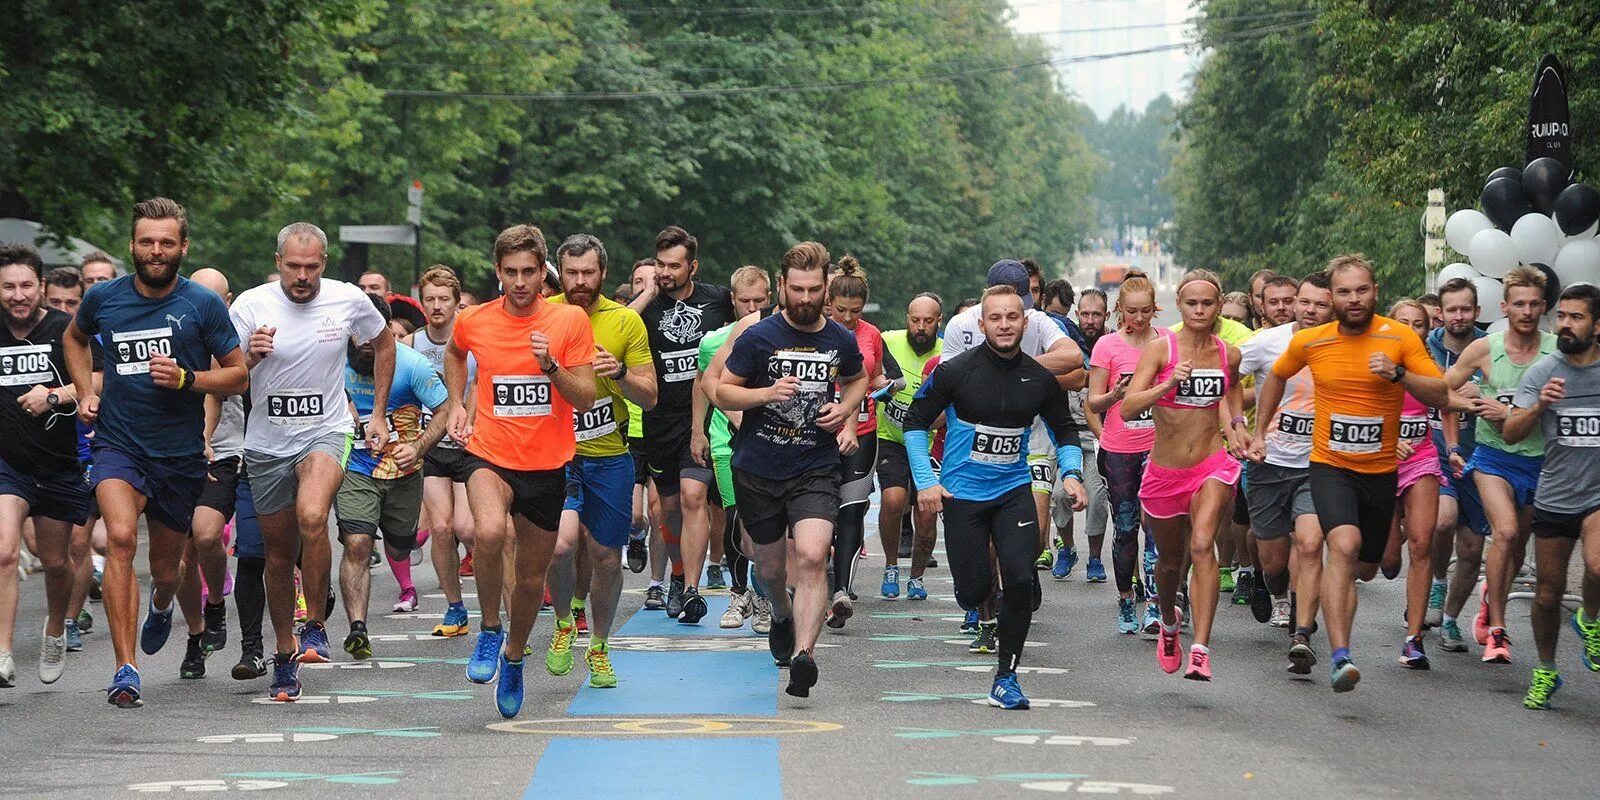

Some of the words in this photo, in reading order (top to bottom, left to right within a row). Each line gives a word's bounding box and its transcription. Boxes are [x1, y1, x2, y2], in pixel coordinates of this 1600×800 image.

[135, 338, 171, 361] 060
[17, 354, 49, 373] 009
[678, 355, 699, 371] 02
[796, 361, 828, 381] 043
[513, 384, 549, 404] 059
[1194, 378, 1222, 396] 021
[287, 396, 320, 416] 049
[583, 406, 612, 429] 012
[1347, 425, 1381, 442] 042
[1400, 422, 1427, 437] 016
[991, 437, 1021, 454] 053
